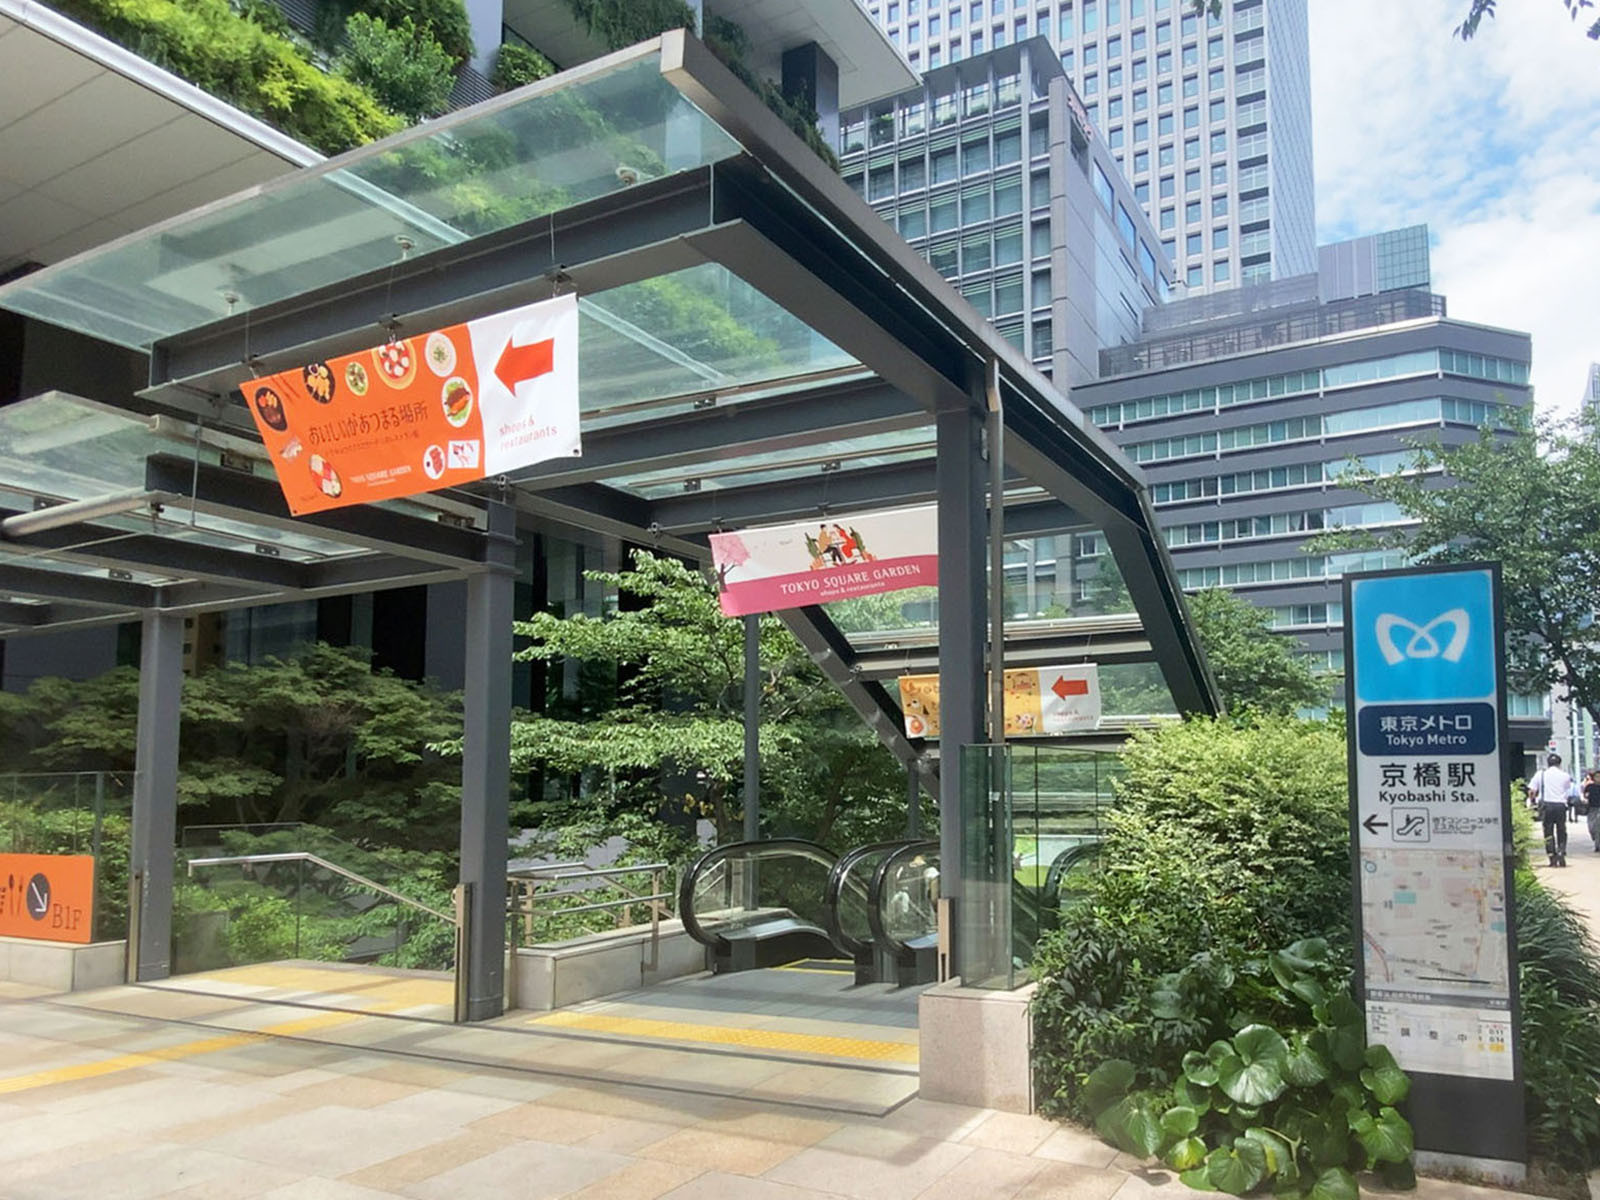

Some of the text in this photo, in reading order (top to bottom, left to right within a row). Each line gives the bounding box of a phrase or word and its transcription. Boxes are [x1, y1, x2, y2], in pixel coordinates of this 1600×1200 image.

[309, 401, 429, 445] おいしいがあつまる場所
[780, 564, 921, 595] TOKYO SQUARE GARDEN
[1380, 715, 1472, 732] 東京メトロ
[1386, 733, 1467, 747] Tokyo Metro
[1380, 762, 1476, 788] 京橋駅
[1379, 789, 1479, 805] Kyobashi Sta.
[52, 903, 82, 931] B1F
